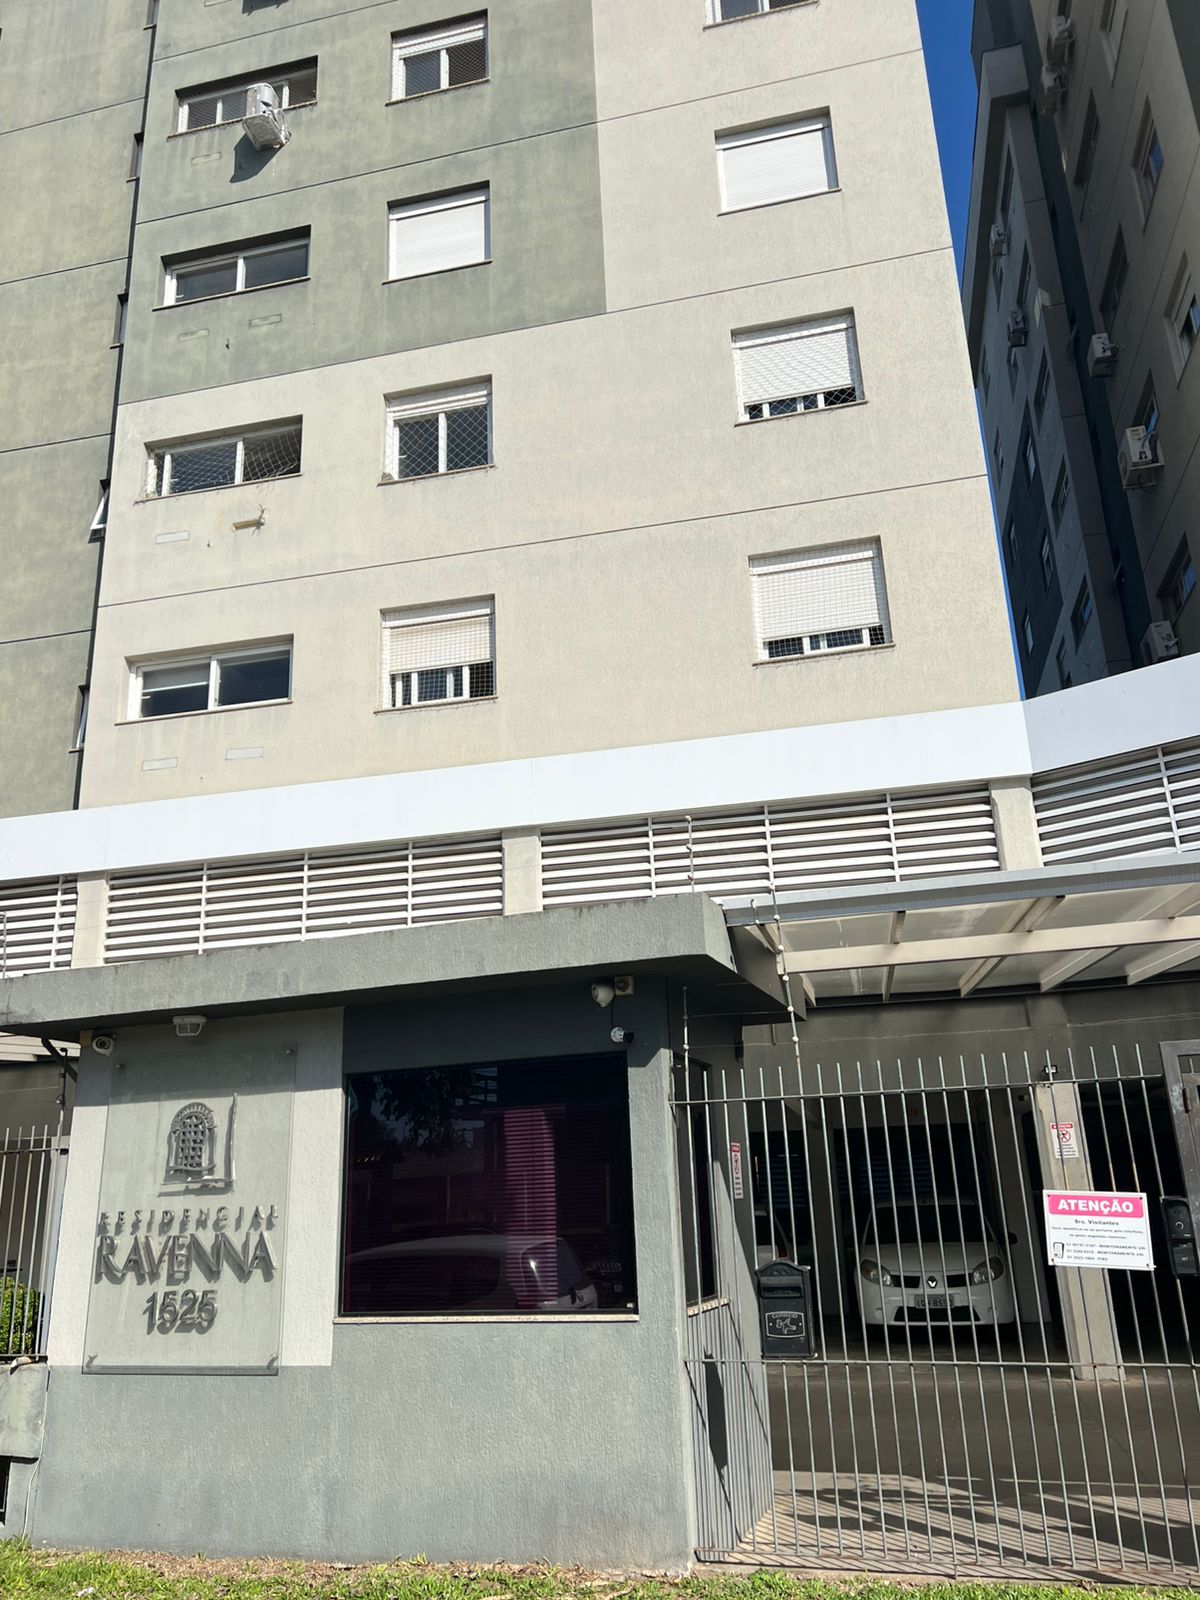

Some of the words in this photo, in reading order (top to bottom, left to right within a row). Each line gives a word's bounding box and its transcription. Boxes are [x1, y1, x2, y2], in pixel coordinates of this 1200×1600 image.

[98, 1204, 279, 1231] RESIDENCIAL
[1058, 1199, 1134, 1215] ATENÇÃO
[97, 1231, 277, 1279] RAVENNA
[145, 1289, 218, 1326] 1525
